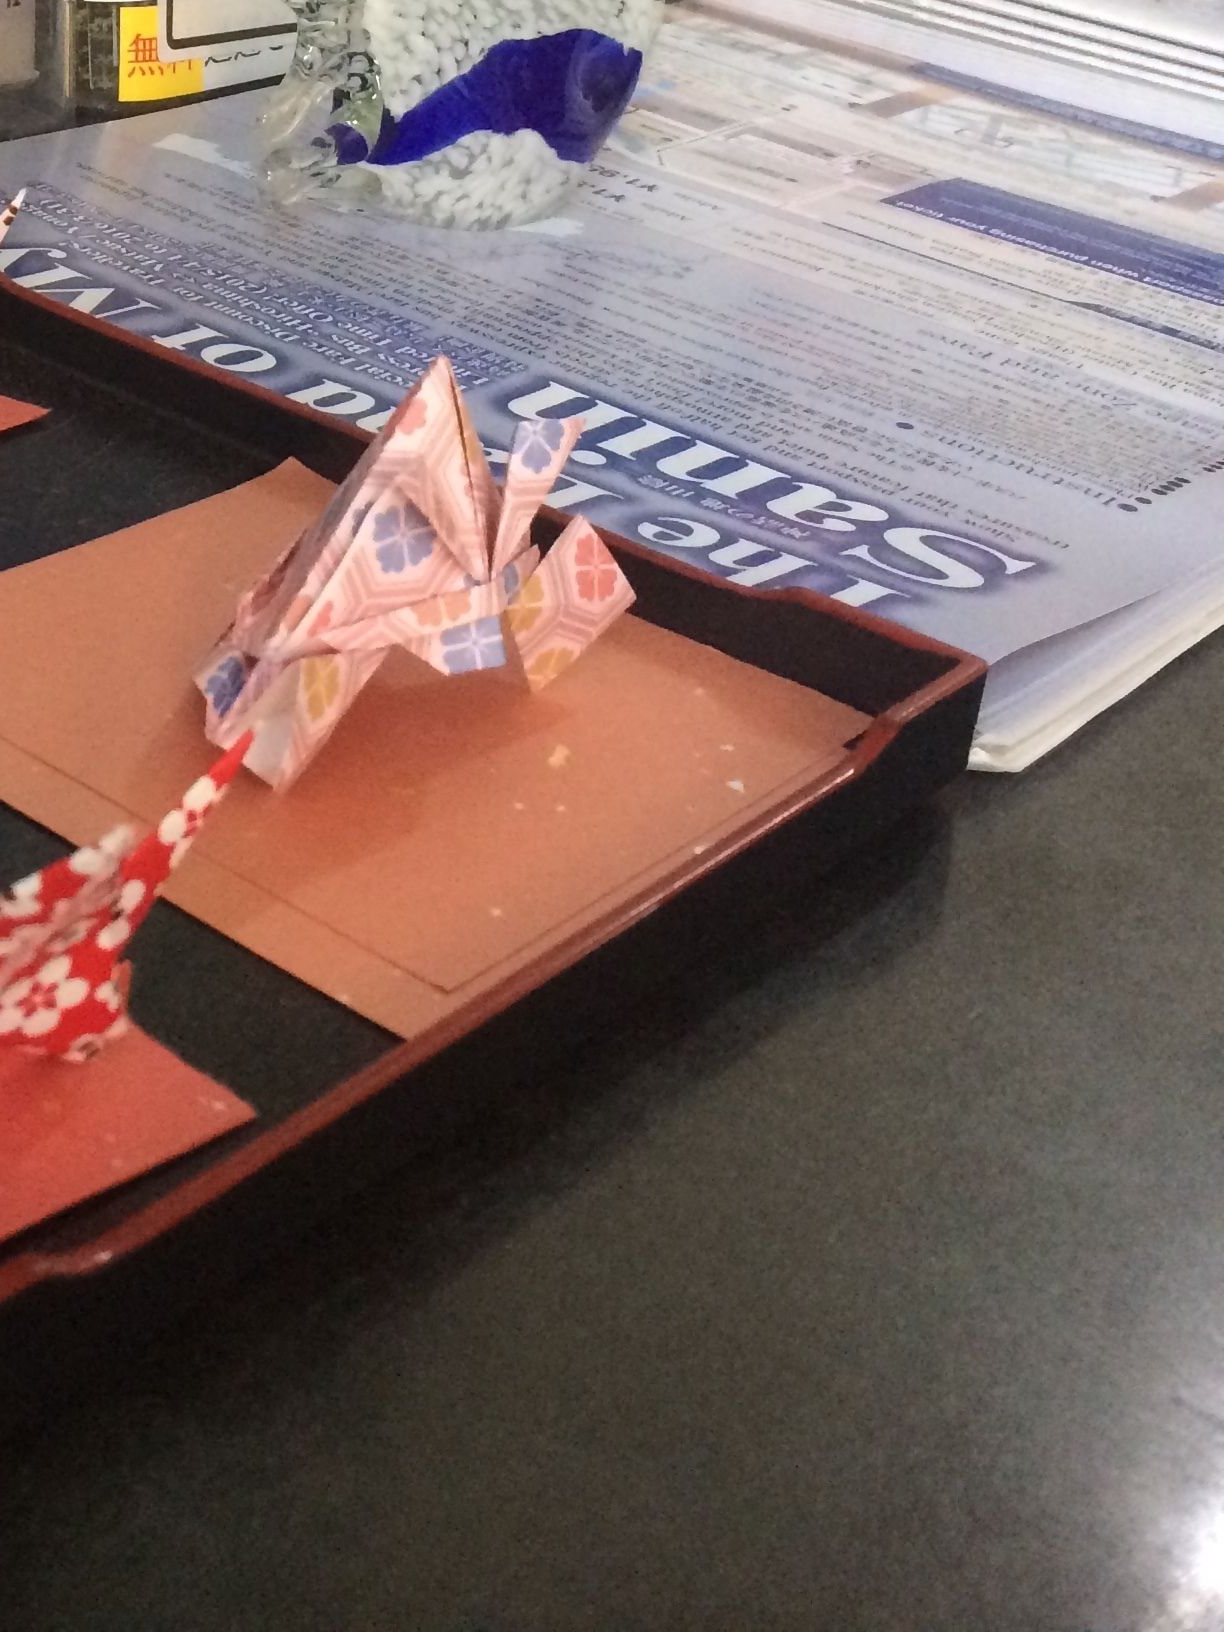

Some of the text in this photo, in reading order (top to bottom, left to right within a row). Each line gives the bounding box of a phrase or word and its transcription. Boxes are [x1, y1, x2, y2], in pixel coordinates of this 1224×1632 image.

[199, 298, 301, 344] Discount
[332, 319, 392, 347] Time
[507, 380, 1037, 589] Sanin
